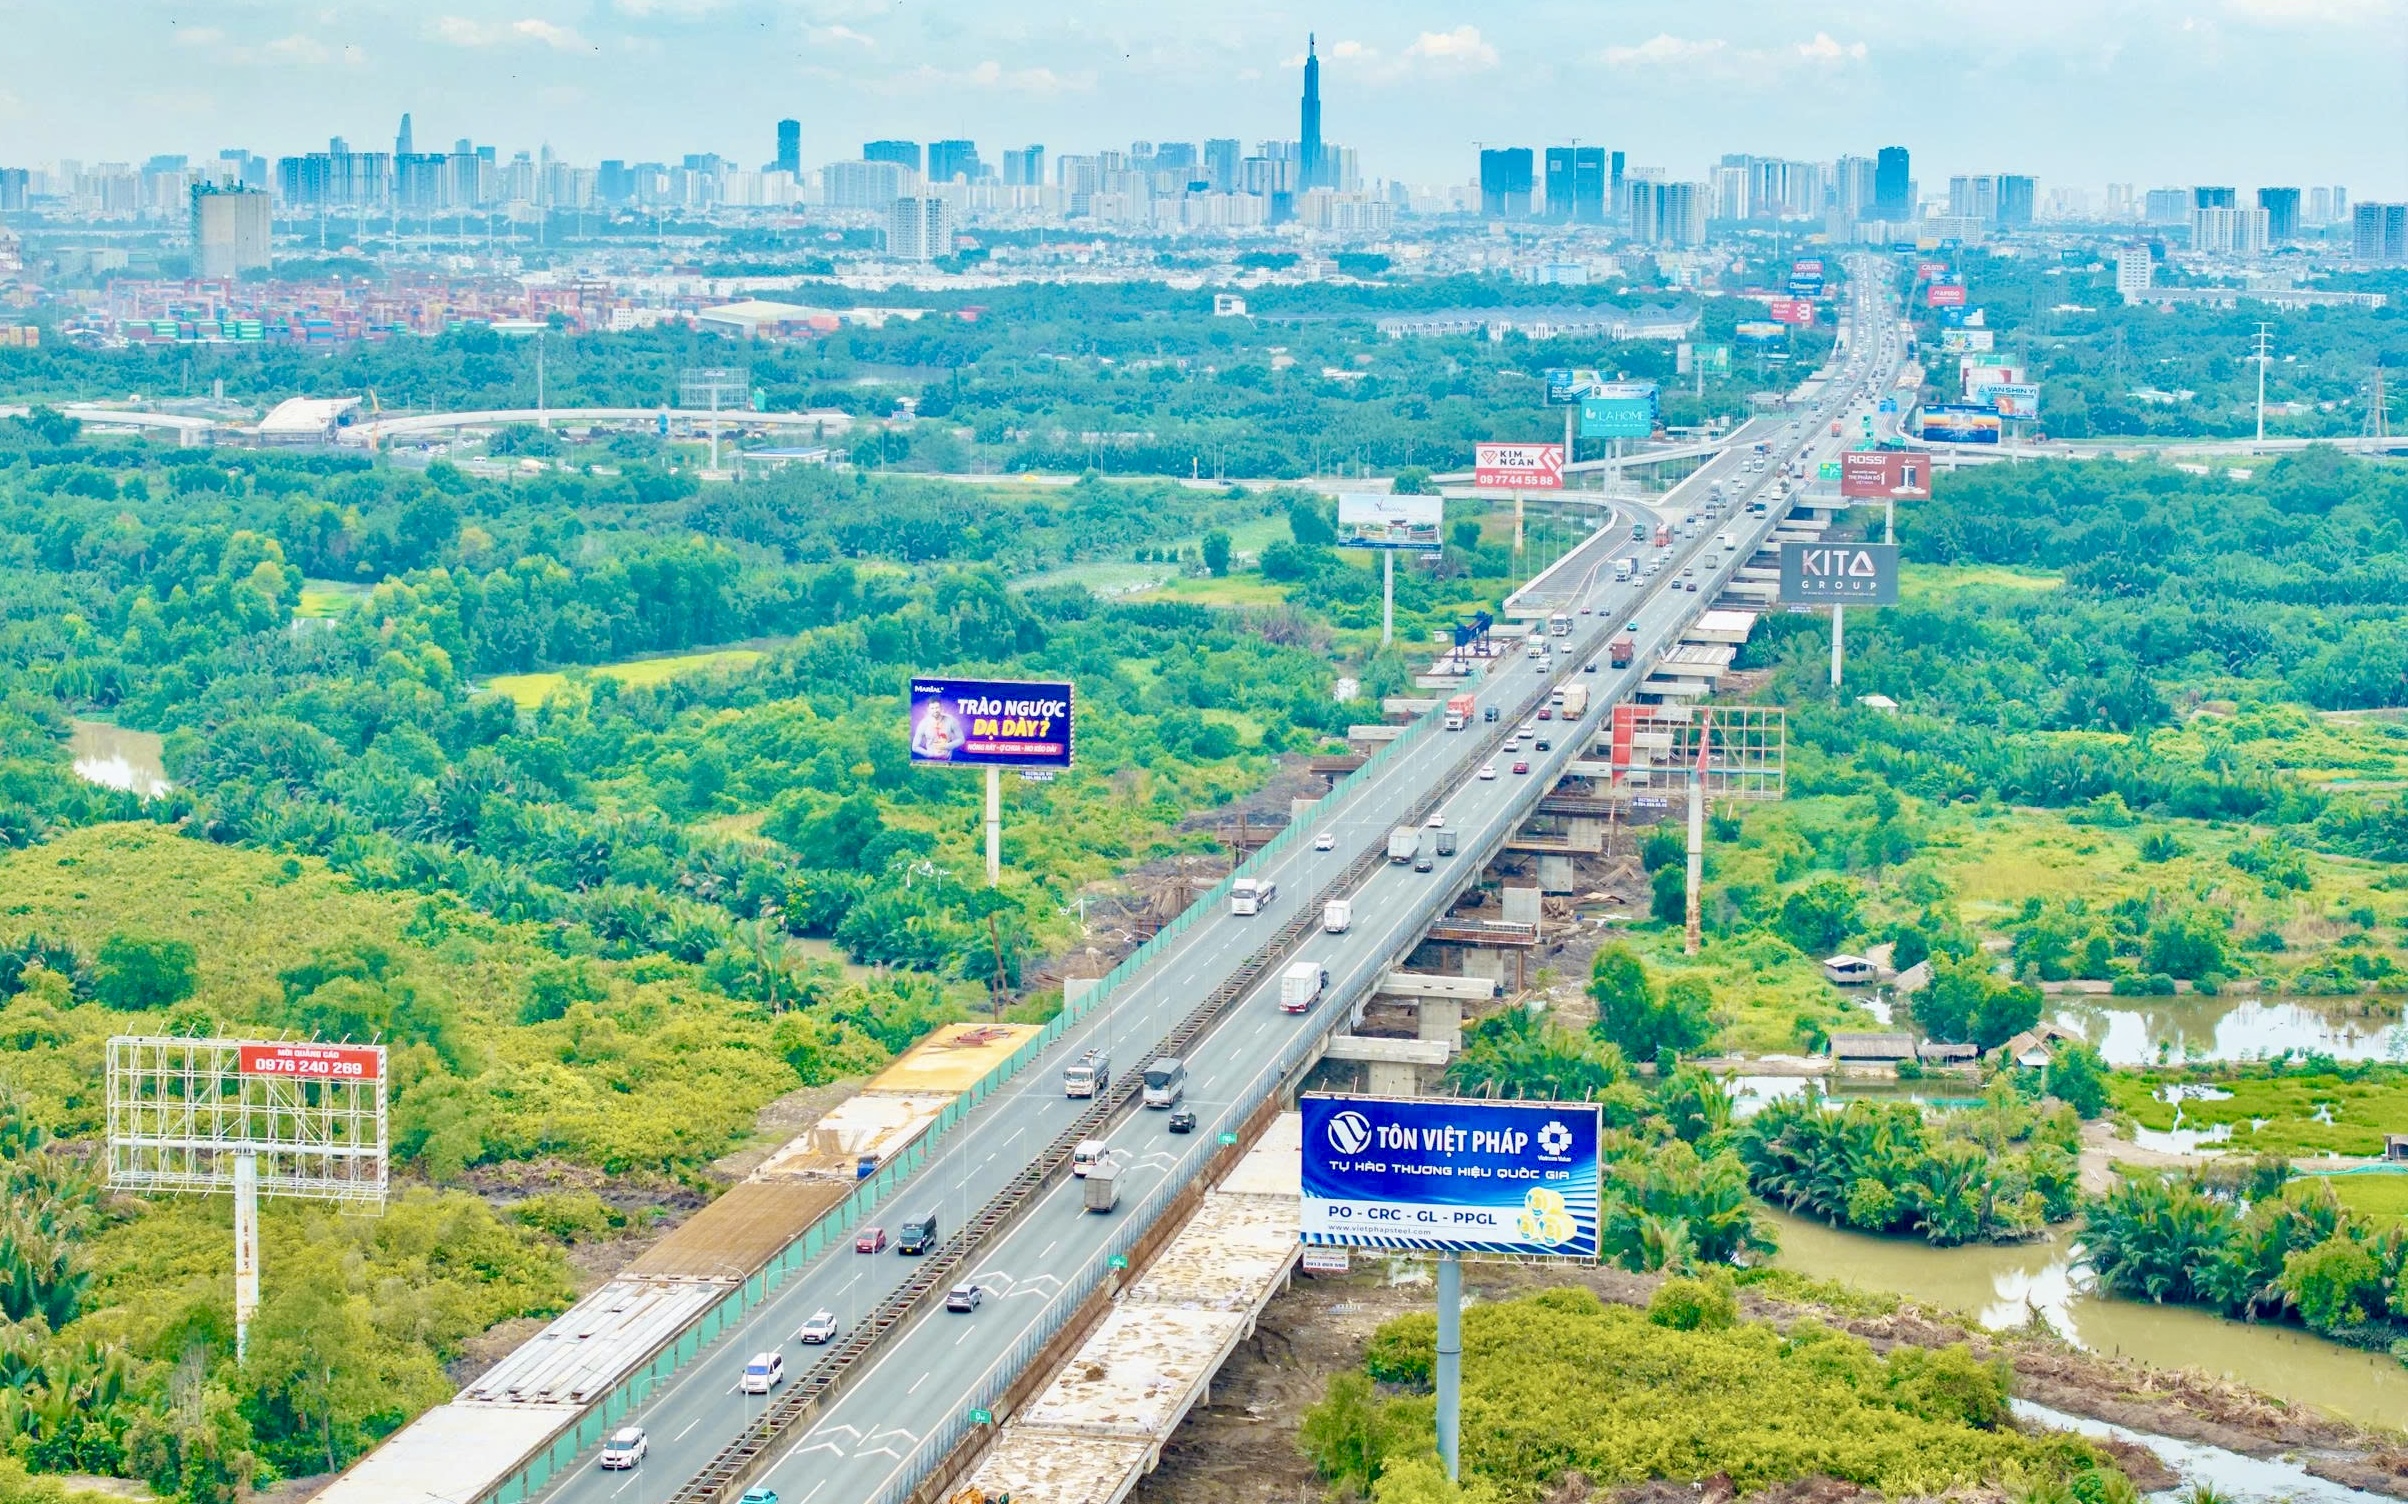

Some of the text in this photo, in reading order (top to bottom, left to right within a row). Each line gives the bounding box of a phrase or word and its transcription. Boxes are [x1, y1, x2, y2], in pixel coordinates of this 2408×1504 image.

[1499, 450, 1523, 458] KIM
[1801, 580, 1877, 590] GROUP
[957, 696, 1067, 721] TRÀO NGƯỢC
[255, 1058, 363, 1075] 0976 240 269
[1376, 1122, 1529, 1158] TÔN VIỆT PHÁP
[1329, 1160, 1350, 1173] TỰ
[1355, 1160, 1387, 1173] HÀO
[1457, 1165, 1492, 1179] HIỆU
[1545, 1170, 1570, 1181] GIA
[1328, 1205, 1498, 1226] PO CRC GL PPGL
[1328, 1224, 1432, 1236] www.vietphapsteel.com
